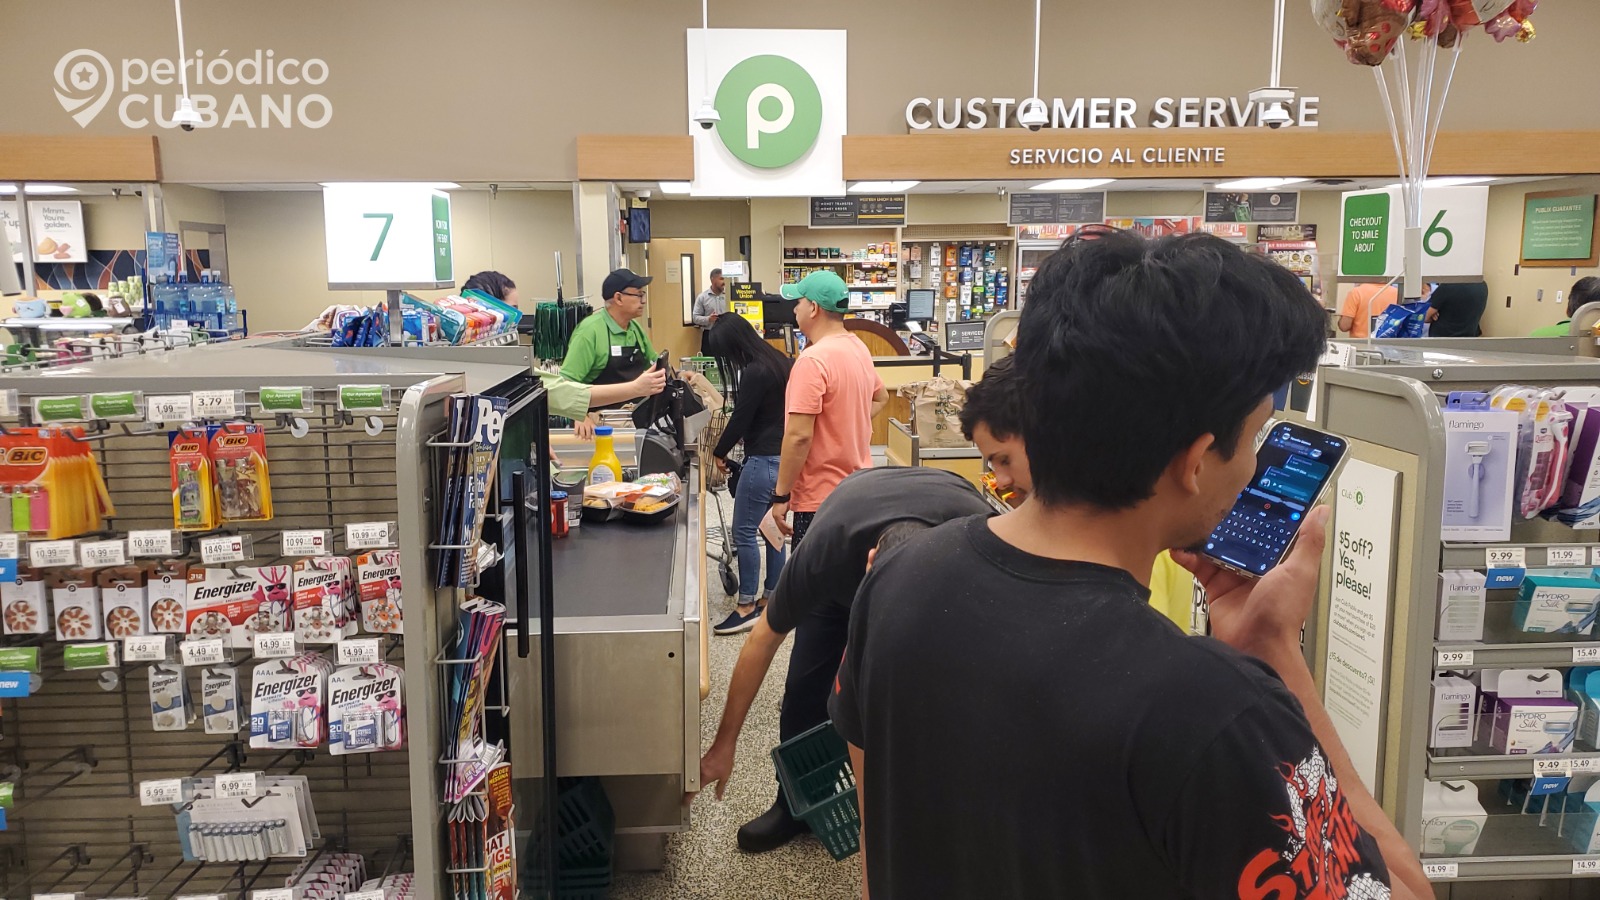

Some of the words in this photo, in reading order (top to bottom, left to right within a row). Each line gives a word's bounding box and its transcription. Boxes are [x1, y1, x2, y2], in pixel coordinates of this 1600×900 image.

[1009, 149, 1104, 164] SERVICIO
[1110, 148, 1136, 163] AL
[1142, 147, 1226, 163] CLIENTE
[44, 221, 72, 229] golden.
[1350, 216, 1383, 227] CHECKOUT
[363, 213, 394, 261] 7
[1352, 231, 1361, 240] TO
[1361, 229, 1379, 240] SMILE
[1422, 209, 1453, 257] 6
[1354, 243, 1375, 252] ABOUT
[198, 397, 222, 407] 3.79
[155, 405, 174, 413] 1.99
[1448, 419, 1485, 431] flamingo
[1341, 488, 1352, 499] Club
[351, 531, 370, 539] 10.99
[133, 539, 154, 547] 10.99
[286, 538, 304, 547] 10.99
[1339, 530, 1350, 547] $5
[1351, 537, 1373, 559] off?
[204, 544, 222, 553] 18.49
[35, 549, 57, 558] 10.99
[86, 549, 107, 558] 10.99
[1490, 552, 1513, 560] 9.99
[1551, 551, 1573, 559] 11.99
[1339, 549, 1357, 575] Yes,
[363, 567, 398, 580] Energizer
[1495, 574, 1515, 582] new
[298, 572, 337, 587] Energizer
[1336, 570, 1371, 600] please!
[1449, 584, 1481, 593] flamingo
[193, 580, 257, 600] Energizer
[1536, 592, 1570, 601] HYDRO
[1541, 599, 1560, 608] Silk
[259, 640, 279, 649] 14.99
[189, 648, 206, 656] 4.49
[342, 648, 362, 656] 14.99
[1577, 649, 1597, 657] 15.49
[1443, 653, 1463, 662] 9.99
[1342, 660, 1367, 680] descuento?
[152, 676, 178, 688] Energizer
[204, 679, 231, 691] Energizer
[254, 674, 318, 699] Energizer
[331, 677, 397, 706] Energizer
[1441, 693, 1471, 701] flamingo
[251, 717, 264, 726] 20
[1513, 713, 1547, 722] HYDRO
[329, 724, 342, 733] 20
[1519, 719, 1538, 729] Silk
[1538, 761, 1560, 769] 9.49
[1570, 760, 1590, 768] 15.49
[221, 782, 240, 791] 9.99
[1542, 782, 1559, 790] new
[145, 788, 164, 798] 9.99
[1427, 865, 1447, 873] 14.99
[1577, 861, 1597, 869] 14.99
